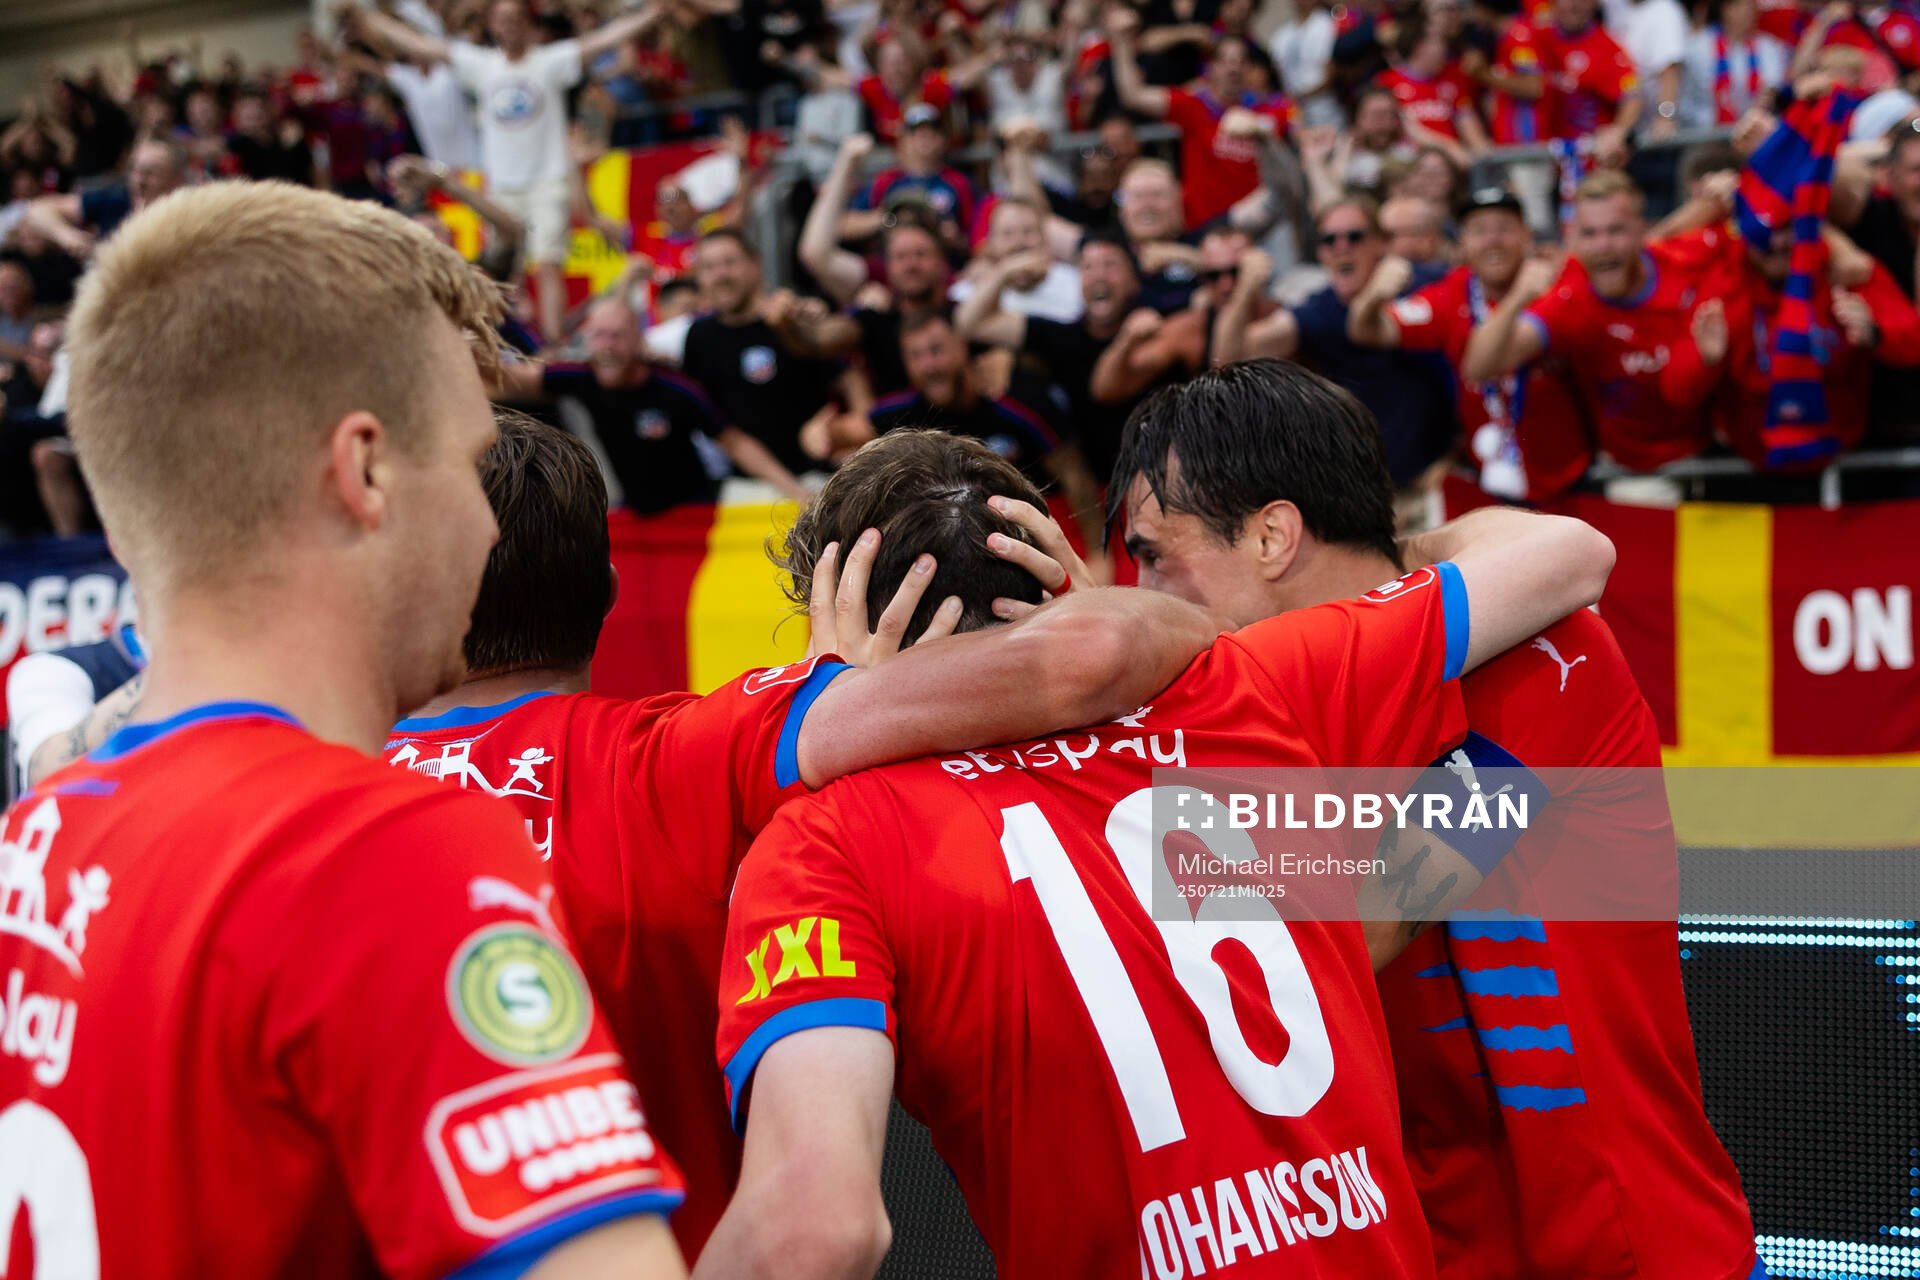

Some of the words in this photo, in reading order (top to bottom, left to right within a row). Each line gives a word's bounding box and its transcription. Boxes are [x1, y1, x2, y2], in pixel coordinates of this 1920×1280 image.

[1793, 586, 1914, 675] ON
[498, 961, 552, 1028] S
[735, 916, 857, 1007] XXL
[1000, 783, 1335, 1153] 16
[0, 968, 79, 1088] lay
[453, 1079, 648, 1177] UNIBE
[1138, 1146, 1387, 1280] OHANSSON
